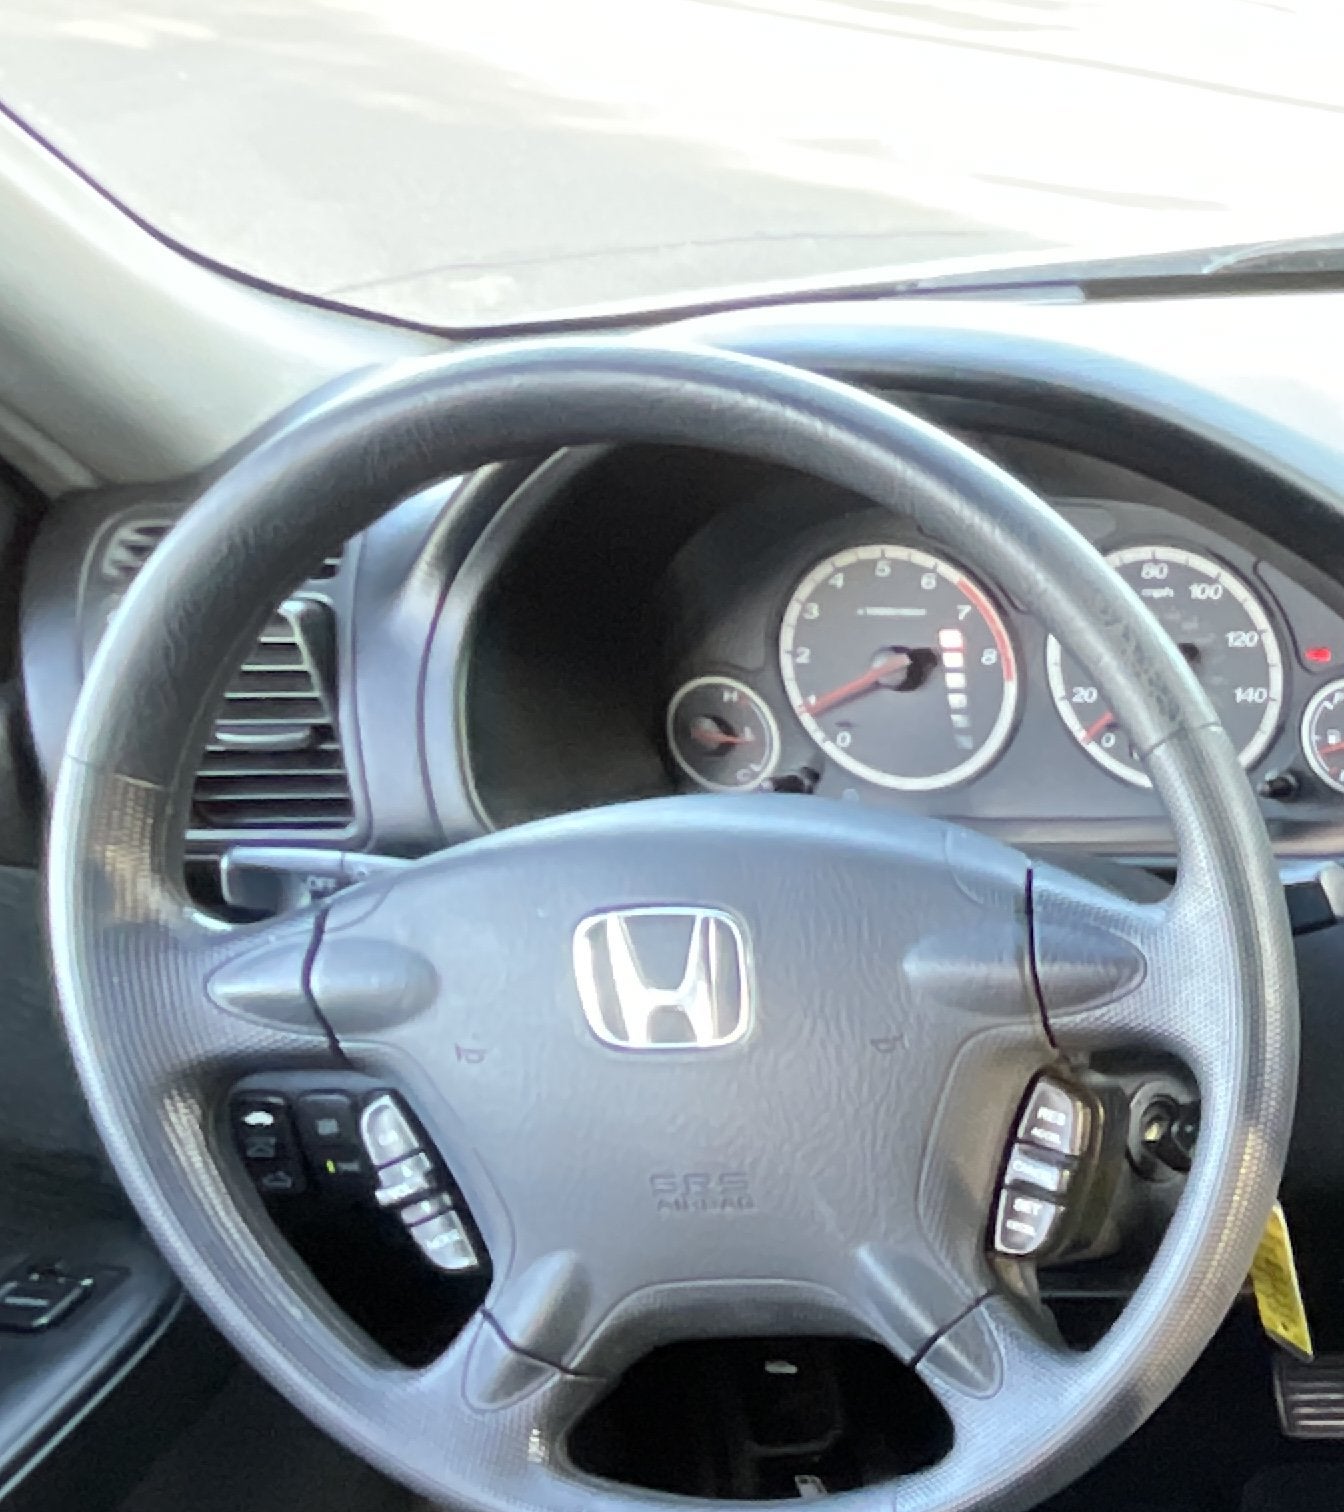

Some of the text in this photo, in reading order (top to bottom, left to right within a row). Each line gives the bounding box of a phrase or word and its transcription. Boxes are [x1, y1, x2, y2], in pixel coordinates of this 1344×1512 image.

[874, 560, 891, 577] 5
[1140, 562, 1169, 580] 80
[828, 572, 845, 590] 4
[920, 572, 937, 590] 6
[1189, 584, 1223, 601] 100
[803, 601, 820, 620] 3
[957, 604, 972, 621] 7
[1225, 631, 1259, 648] 120
[796, 647, 811, 664] 2
[981, 648, 998, 666] 8
[1072, 687, 1098, 704] 20
[1235, 687, 1268, 704] 140
[836, 730, 853, 748] 0
[1100, 733, 1116, 749] 0
[648, 1171, 750, 1197] SRS
